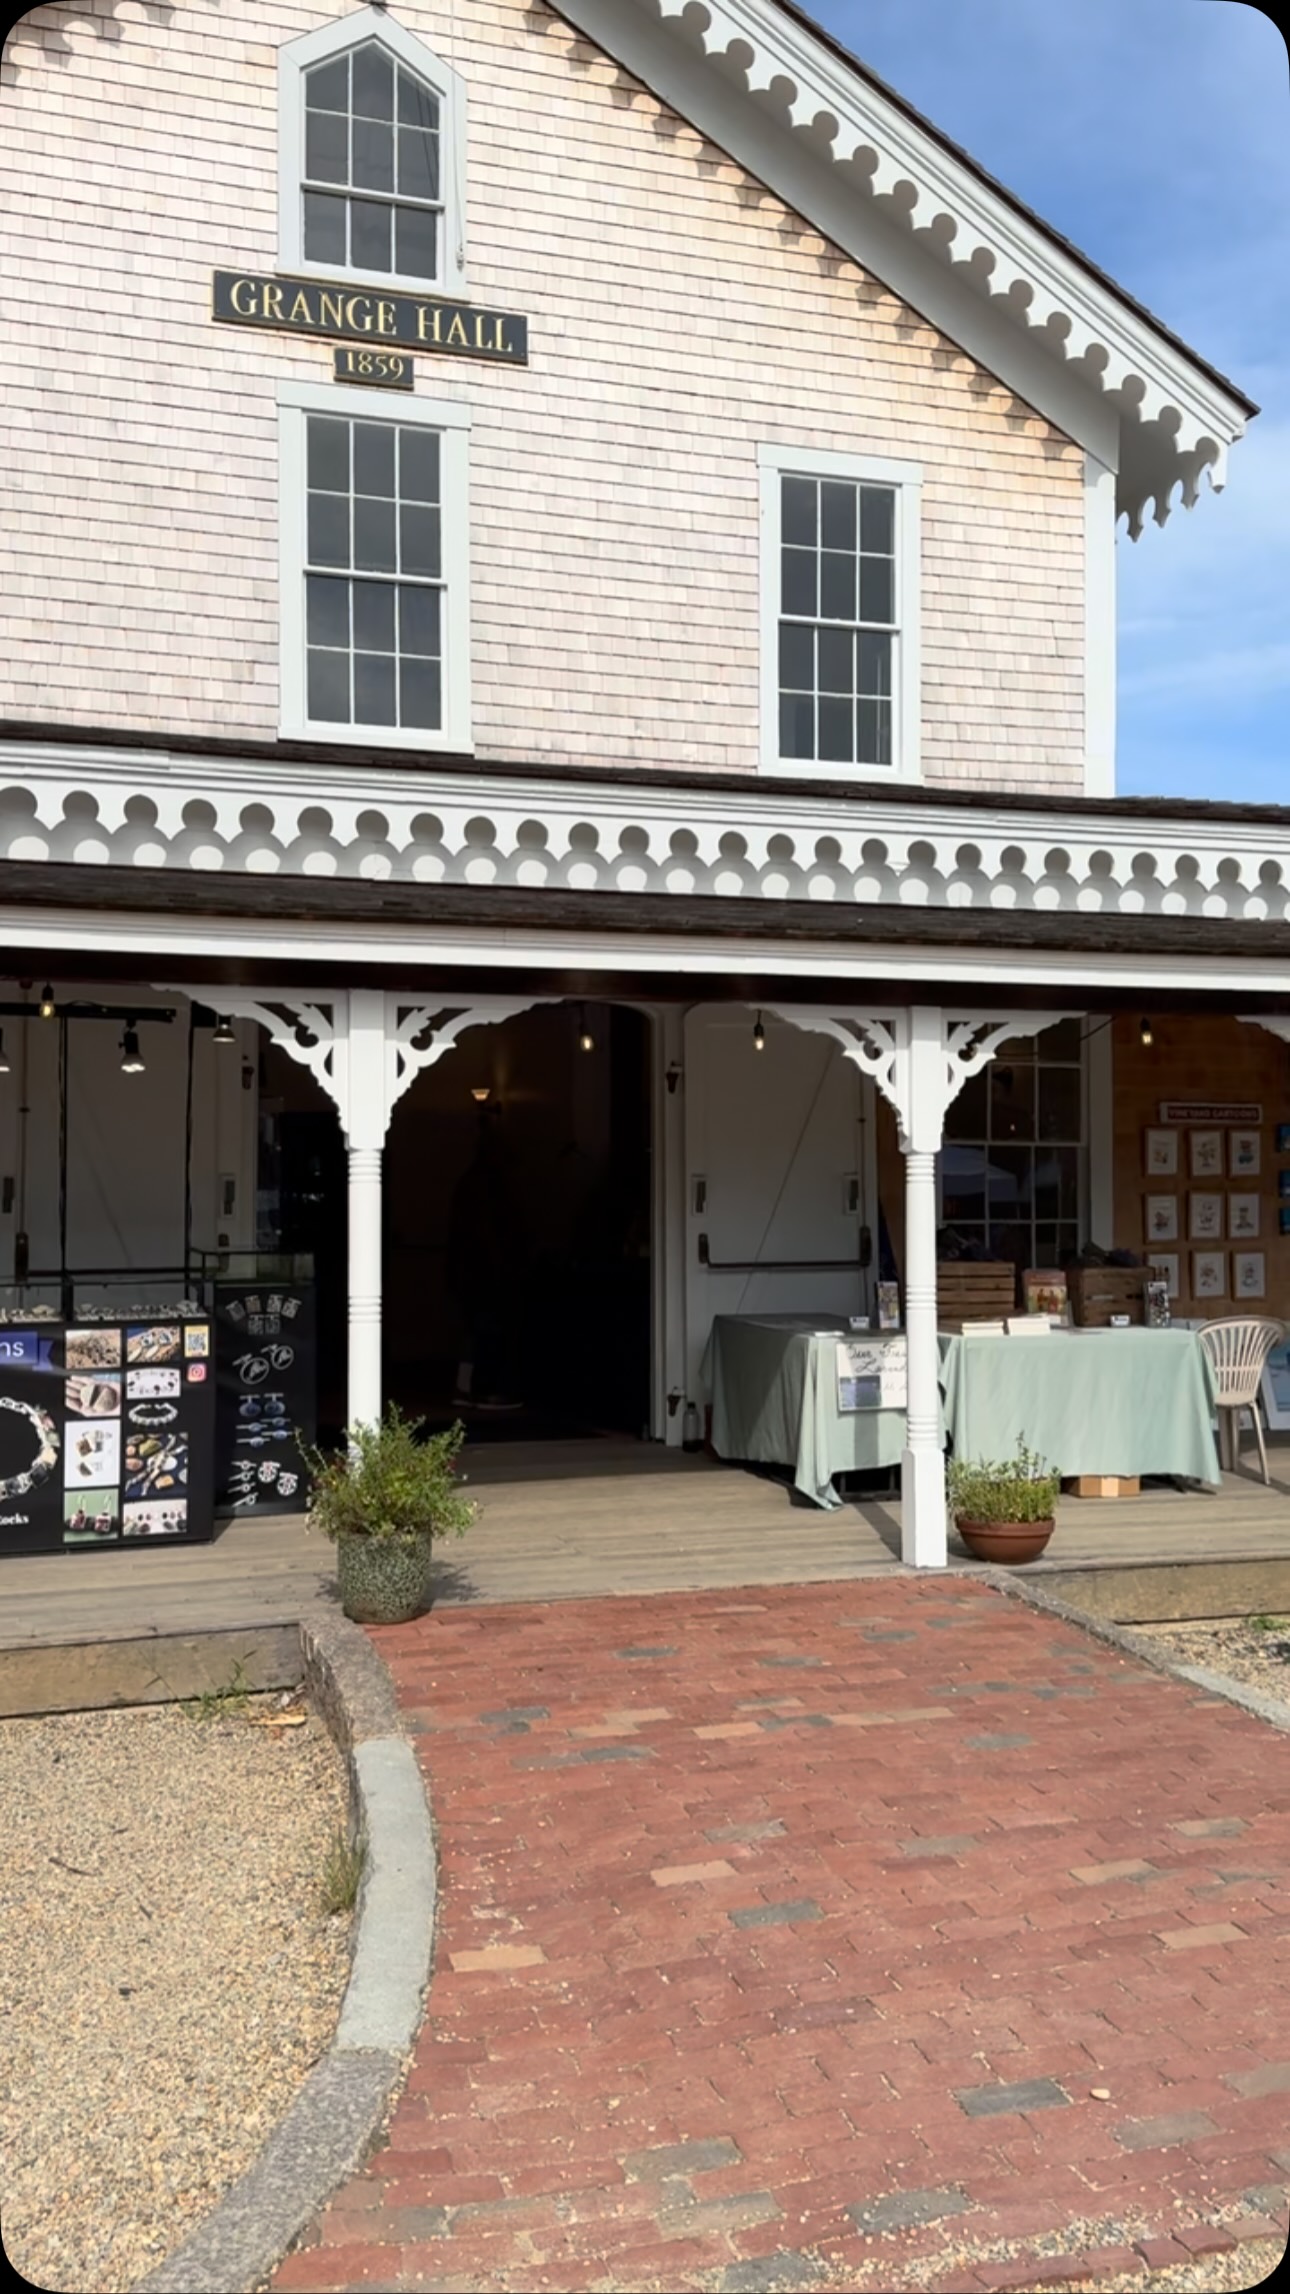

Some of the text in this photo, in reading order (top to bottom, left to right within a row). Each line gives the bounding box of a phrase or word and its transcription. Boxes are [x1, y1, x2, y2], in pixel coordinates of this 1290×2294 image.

[229, 278, 513, 353] GRANGE HALL
[345, 350, 405, 380] 1859
